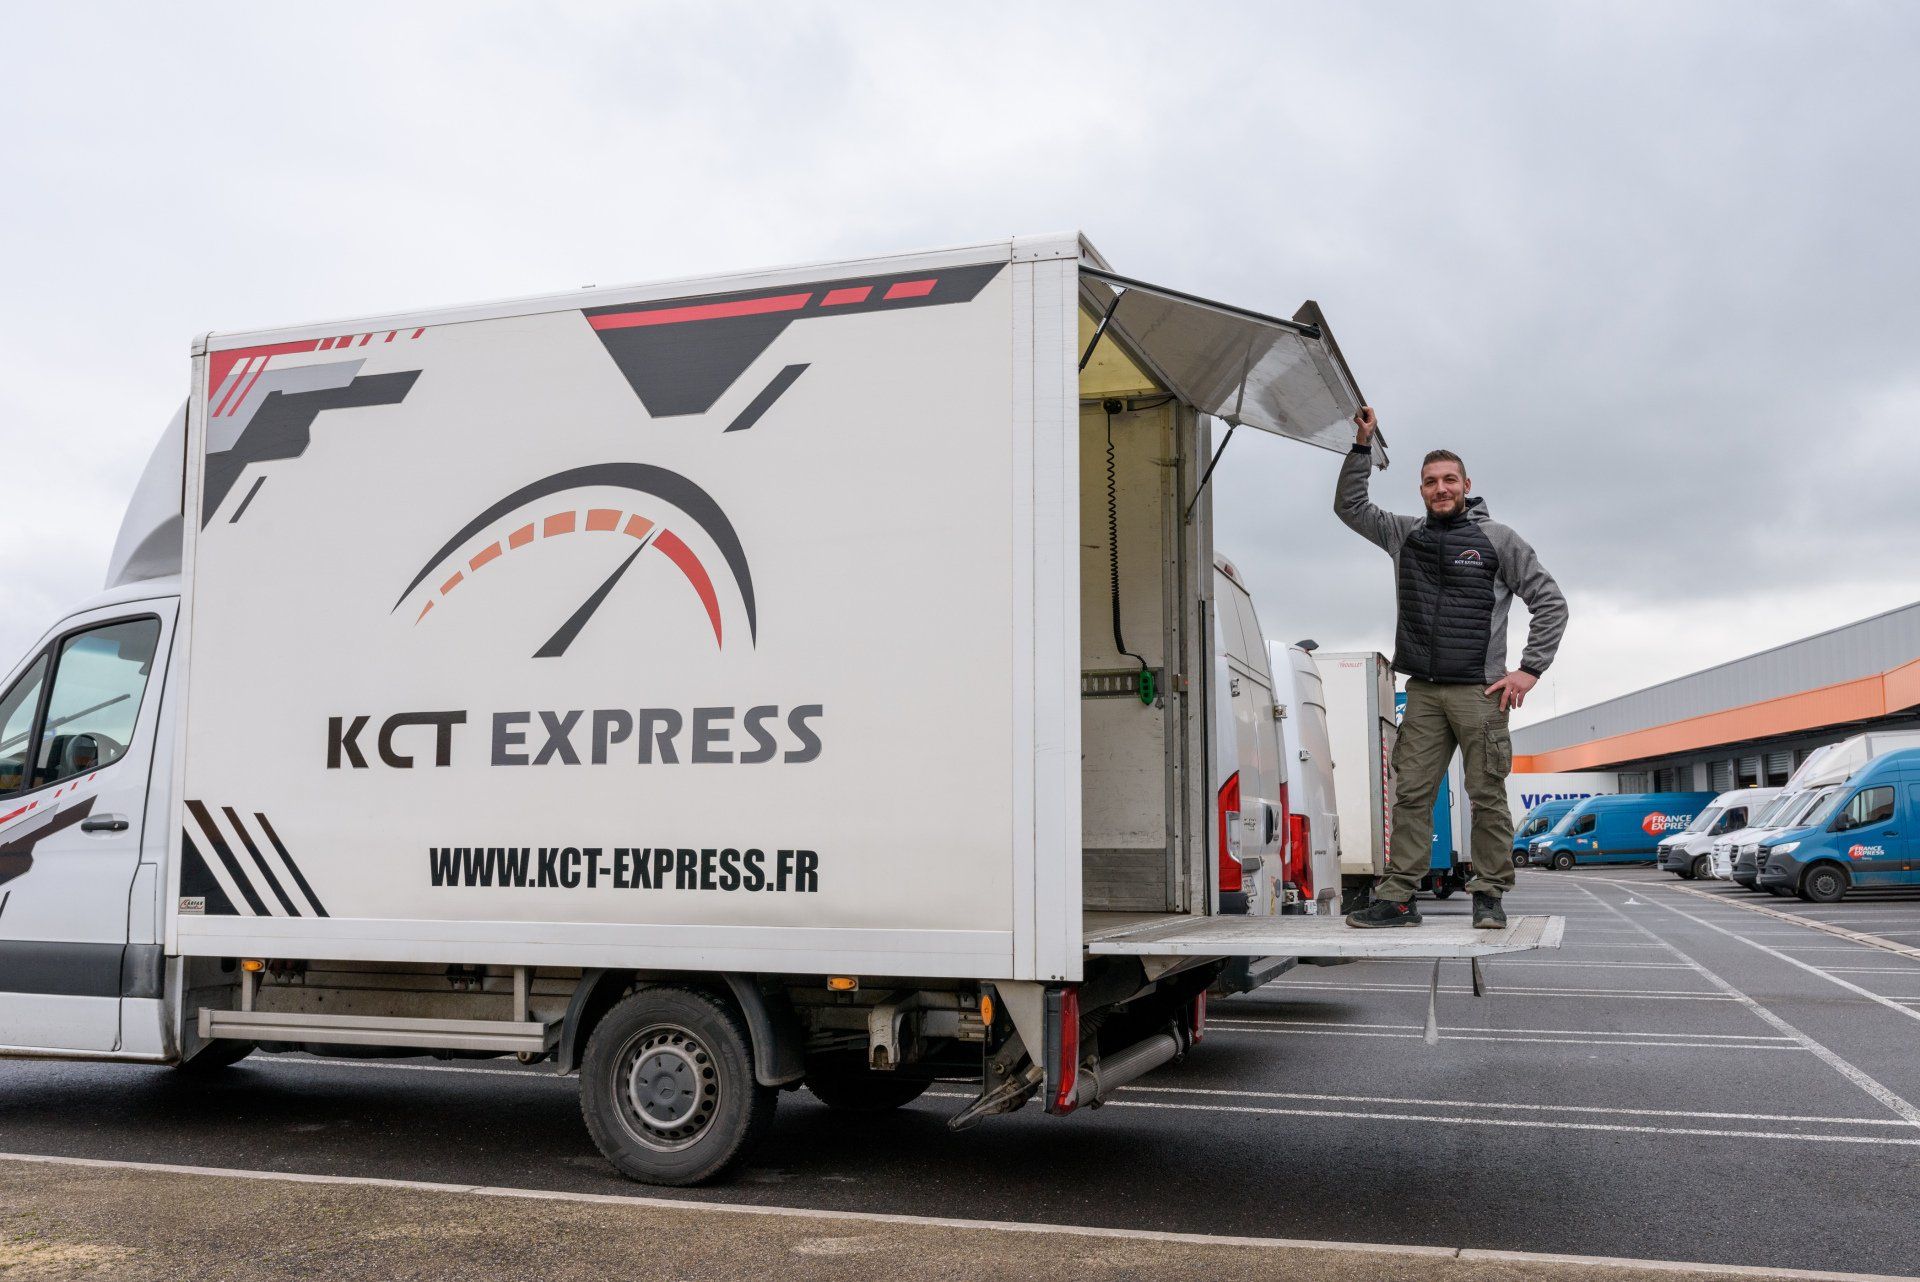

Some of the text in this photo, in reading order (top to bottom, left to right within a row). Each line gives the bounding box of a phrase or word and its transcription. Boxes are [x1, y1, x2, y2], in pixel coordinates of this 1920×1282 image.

[326, 703, 824, 769] KCT EXPRESS
[1651, 821, 1690, 830] EXPRES
[1652, 815, 1692, 823] FRANCE
[429, 847, 819, 893] WWW.KCT-EXPRESS.FR
